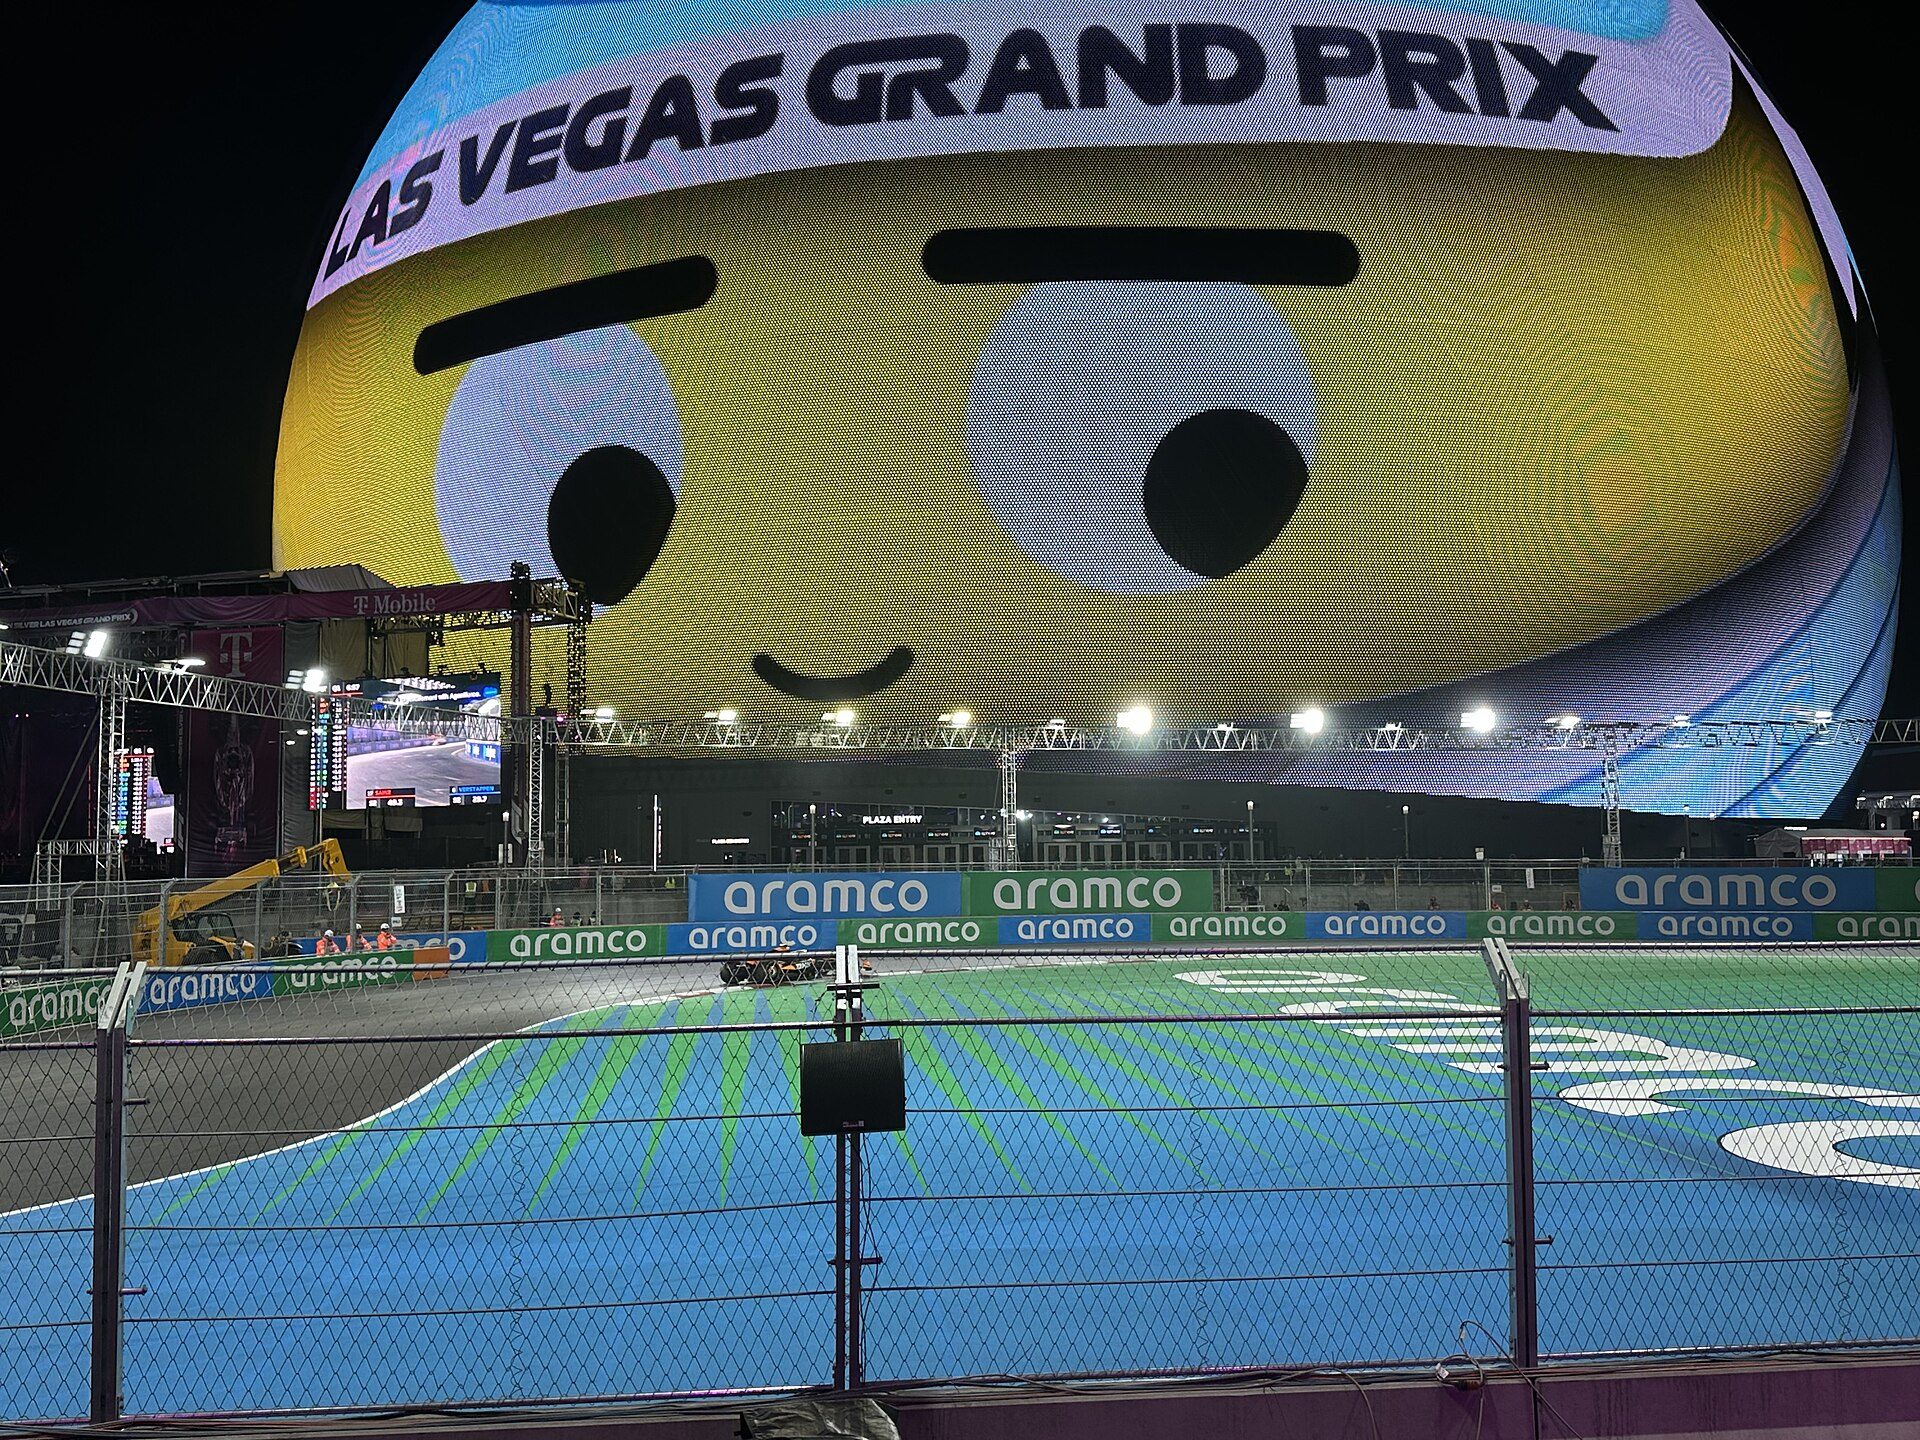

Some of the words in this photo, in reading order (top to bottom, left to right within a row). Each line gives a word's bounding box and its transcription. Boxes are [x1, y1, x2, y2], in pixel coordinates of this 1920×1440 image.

[323, 149, 444, 282] LAS
[458, 53, 785, 206] VEGAS
[805, 22, 1267, 127] GRAND
[1291, 24, 1621, 133] PRIX
[373, 593, 436, 614] Mobile
[40, 619, 56, 628] LAS
[57, 617, 83, 627] VEGAS
[84, 615, 111, 625] GRAND
[111, 612, 131, 622] PRIX
[862, 815, 892, 824] PLAZA
[893, 814, 923, 824] ENTRY
[724, 880, 929, 914] aramco
[993, 876, 1182, 910] aramco
[1615, 873, 1836, 907] aramco
[858, 921, 980, 944] aramco
[1017, 918, 1134, 940] aramco
[1170, 916, 1287, 936] aramco
[1324, 914, 1446, 935] aramco
[1487, 914, 1615, 936] aramco
[1657, 915, 1793, 937] aramco
[510, 930, 647, 957] aramco
[689, 924, 817, 949] aramco
[150, 970, 256, 1005] aramco
